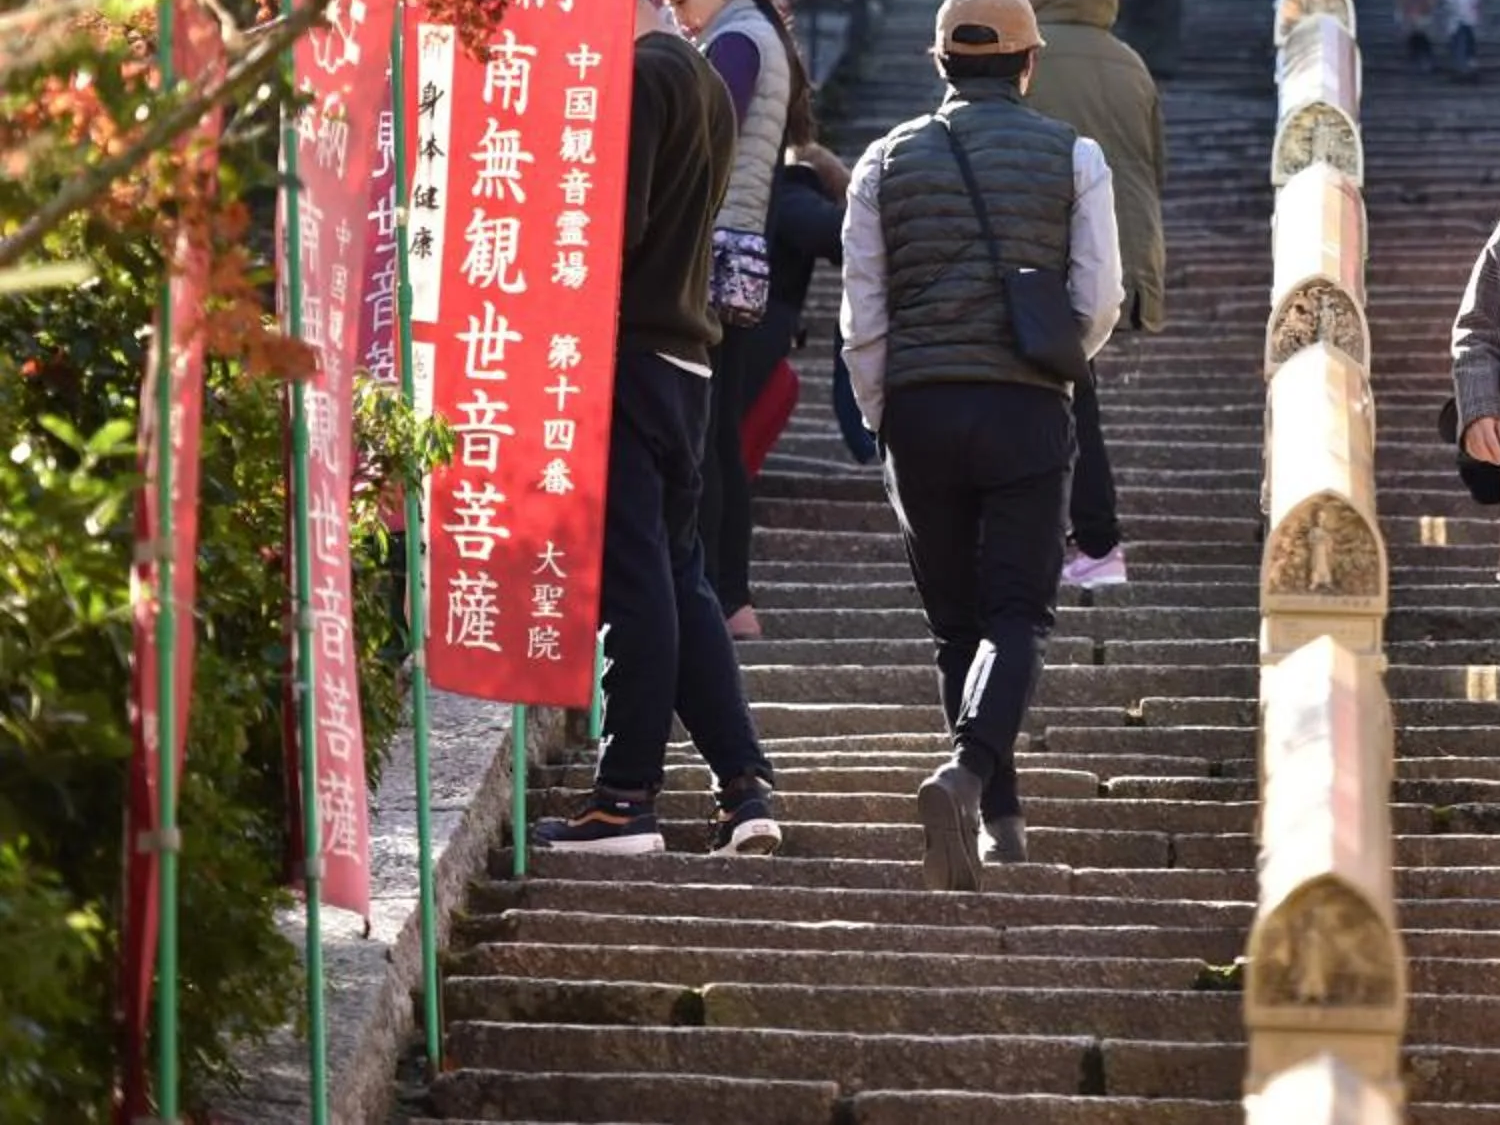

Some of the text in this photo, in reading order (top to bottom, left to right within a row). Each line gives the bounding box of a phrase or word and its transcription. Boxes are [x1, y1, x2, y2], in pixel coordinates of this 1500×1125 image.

[408, 80, 446, 259] 身体健康
[443, 30, 537, 652] 南無観世音菩薩
[527, 43, 602, 661] 中国観音霊場 第十四番 大聖院
